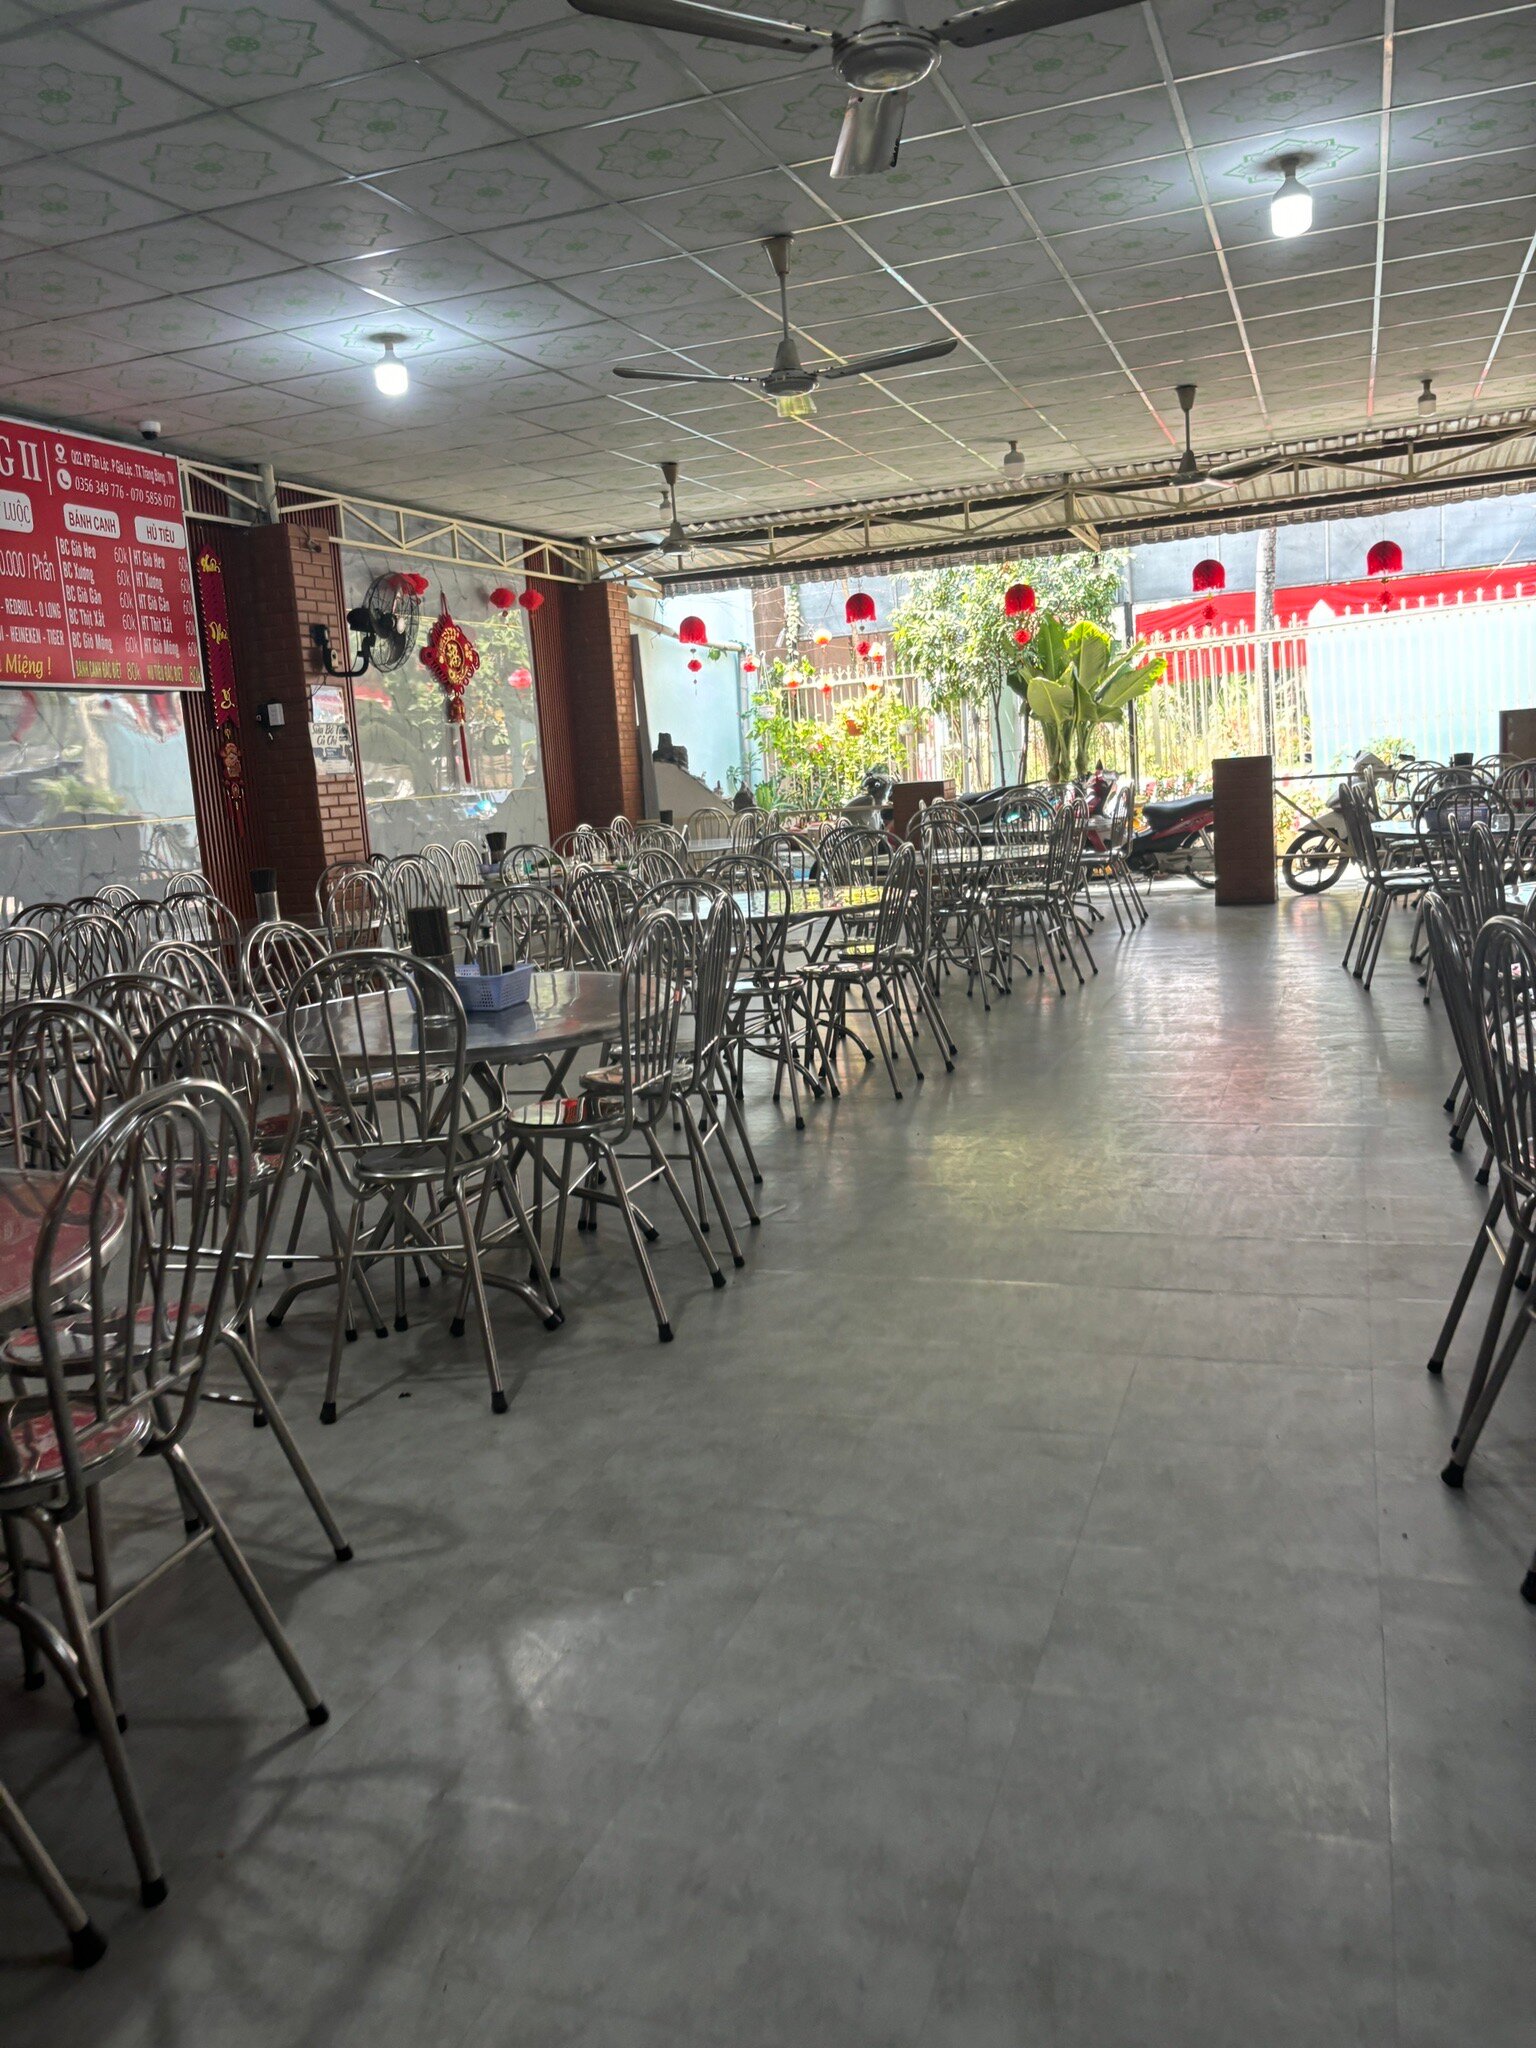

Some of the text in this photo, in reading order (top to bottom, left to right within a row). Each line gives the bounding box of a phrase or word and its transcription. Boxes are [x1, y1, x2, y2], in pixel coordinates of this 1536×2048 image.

[100, 456, 110, 474] Lộc
[116, 460, 124, 475] Gia
[124, 462, 133, 478] Lộc
[75, 476, 94, 493] 0356
[96, 480, 109, 496] 349
[111, 484, 124, 499] 776
[130, 488, 144, 502] 070
[146, 490, 162, 506] 5858
[164, 494, 176, 509] 077
[4, 500, 31, 527] LUỘC
[68, 510, 116, 533] BÁNH CANH
[60, 538, 129, 564] BC Giò Heo 60k
[133, 550, 141, 566] HT
[153, 552, 165, 569] Heo
[32, 552, 56, 582] Phần
[62, 561, 73, 579] BC
[117, 570, 131, 586] 60k
[136, 572, 144, 587] HT
[66, 585, 76, 602] BC
[120, 592, 134, 608] 60k
[138, 594, 146, 609] HT
[5, 598, 34, 616] REDBULL
[45, 602, 62, 619] LONG
[68, 608, 79, 624] BC
[79, 609, 93, 629] Thịt
[122, 614, 136, 630] 60k
[141, 615, 149, 631] HT
[10, 626, 41, 644] HEINEKEN
[46, 629, 65, 645] TIGER
[71, 632, 81, 648] BC
[125, 637, 139, 653] 60k
[144, 638, 152, 653] HT
[6, 653, 43, 679] Miệng
